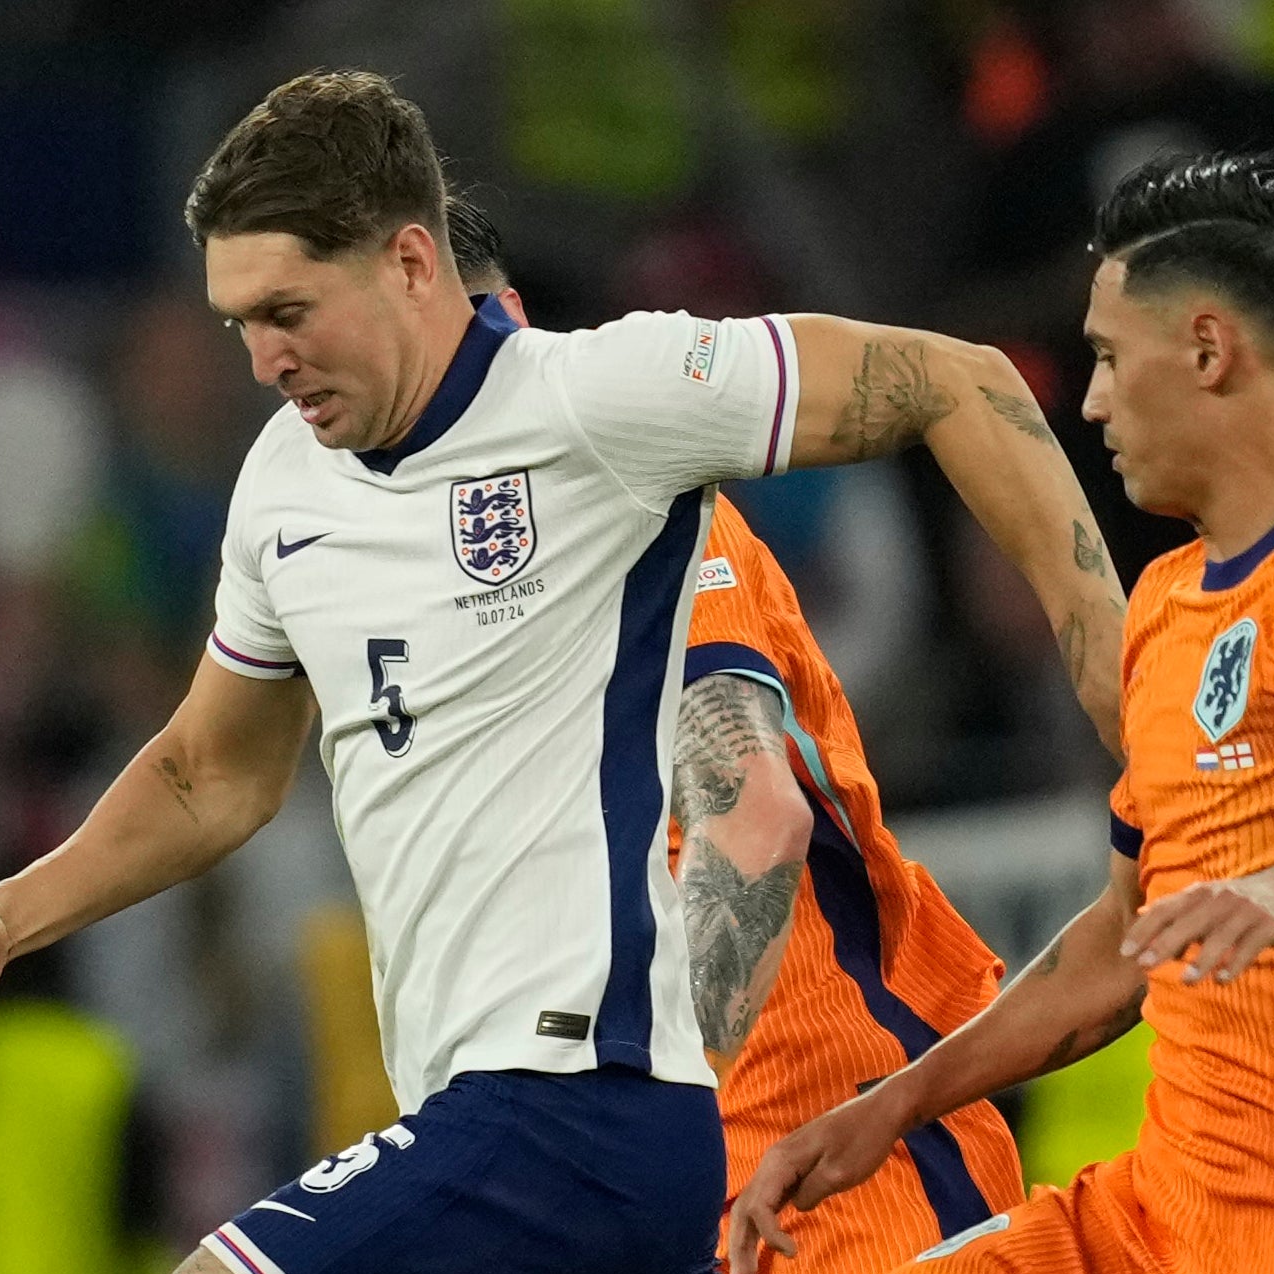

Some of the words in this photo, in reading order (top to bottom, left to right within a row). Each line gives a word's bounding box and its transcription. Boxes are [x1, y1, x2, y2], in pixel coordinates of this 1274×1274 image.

[453, 578, 546, 611] NETHERLANDS
[475, 603, 525, 627] 10.07.24
[367, 638, 418, 758] 5
